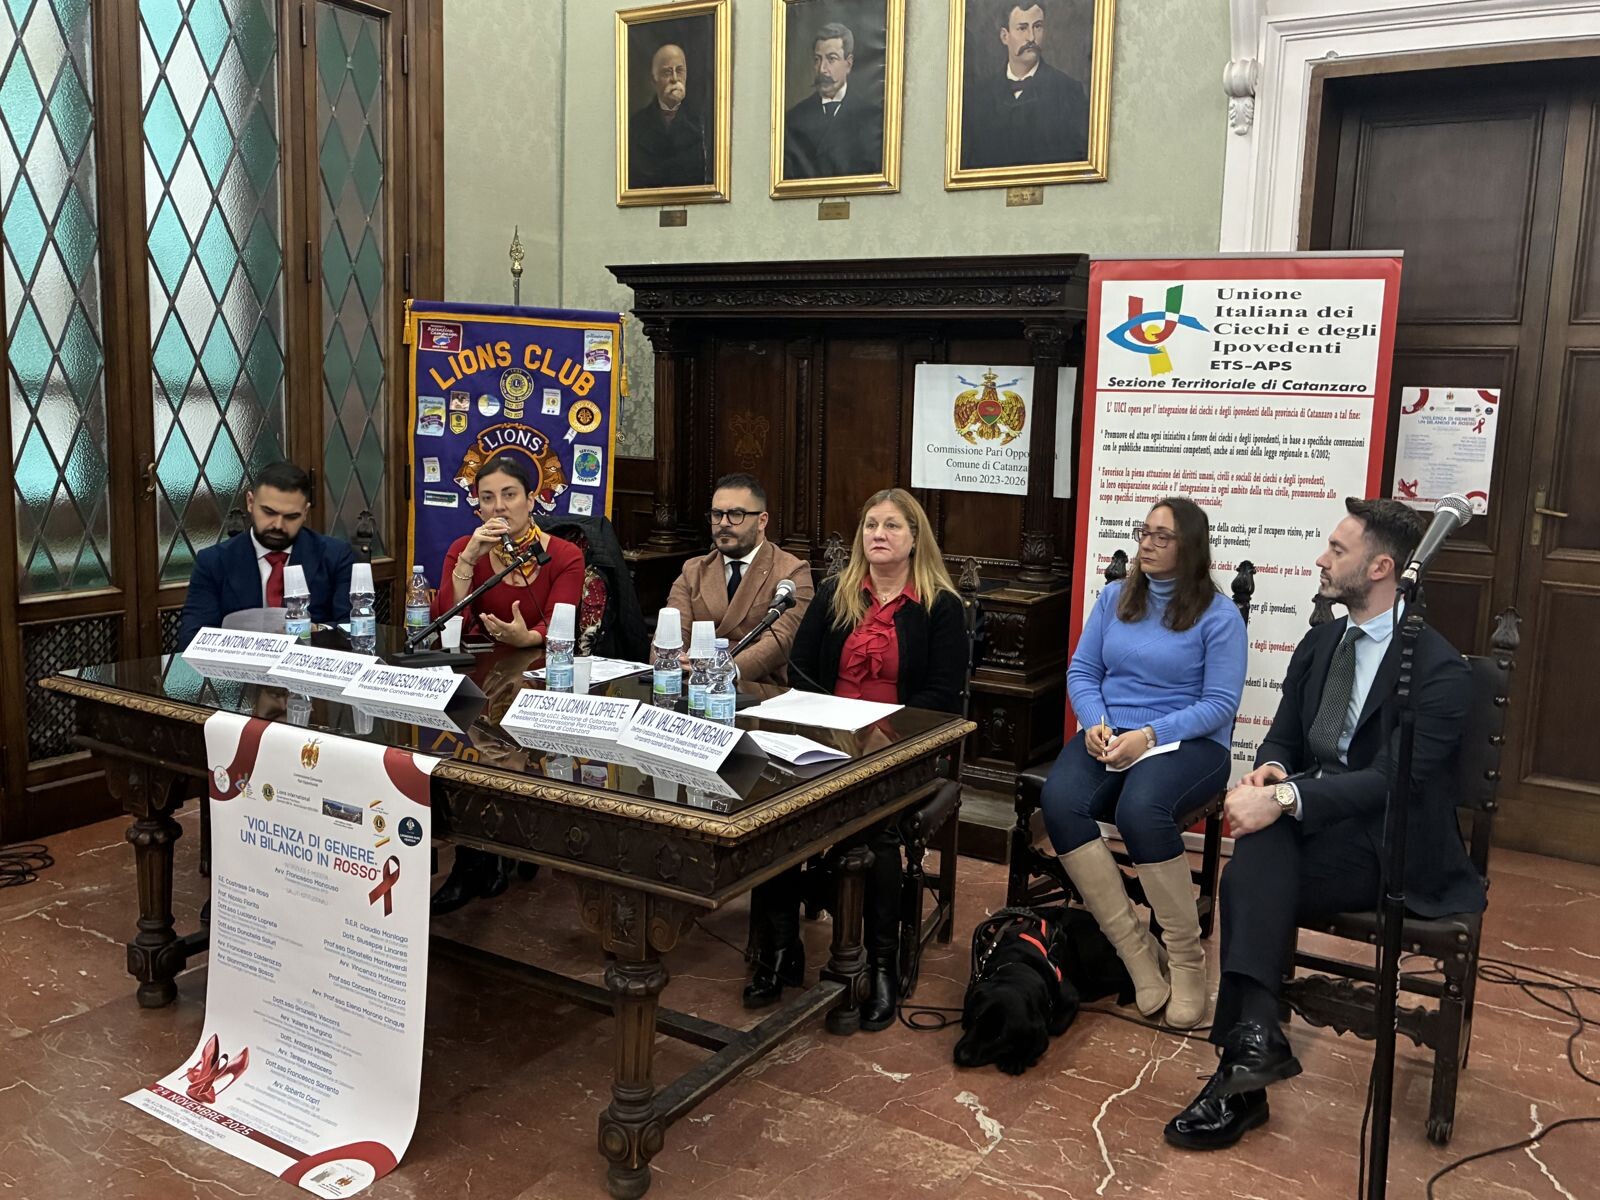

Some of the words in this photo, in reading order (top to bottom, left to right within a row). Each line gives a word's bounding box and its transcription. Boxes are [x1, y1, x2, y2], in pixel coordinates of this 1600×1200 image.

[1216, 288, 1303, 301] Unione
[1215, 306, 1307, 318] Italiana
[1316, 305, 1354, 318] dei
[1213, 323, 1290, 336] Ciechi
[1297, 326, 1310, 336] e
[1317, 324, 1377, 340] degli
[1212, 340, 1342, 355] Ipovedenti
[429, 341, 512, 390] LIONS
[524, 344, 596, 397] CLUB
[1210, 360, 1293, 371] ETS-APS
[1107, 377, 1167, 388] Sezione
[1171, 378, 1256, 390] Territoriale
[1261, 379, 1278, 390] di
[1281, 380, 1368, 393] Catanzaro
[1113, 403, 1126, 413] UICI
[1127, 406, 1141, 415] opera
[1157, 404, 1187, 417] integrazione
[1189, 405, 1197, 415] dei
[1198, 405, 1212, 415] ciechi
[1219, 406, 1231, 418] degli
[1232, 406, 1259, 419] ipovedenti
[1260, 407, 1273, 417] della
[1274, 407, 1298, 420] provincia
[1306, 408, 1332, 419] Catanzaro
[1339, 409, 1347, 419] tal
[1348, 409, 1360, 419] fine:
[483, 429, 543, 452] LIONS
[1104, 429, 1127, 439] Promuove
[1136, 431, 1149, 440] attua
[1150, 430, 1161, 442] ogni
[1162, 430, 1185, 441] iniziativa
[1191, 431, 1207, 442] favore
[1208, 432, 1216, 442] dei
[1218, 432, 1232, 442] ciechi
[1238, 433, 1251, 445] degli
[1252, 433, 1280, 446] ipovedenti,
[1289, 434, 1300, 444] base
[1307, 435, 1331, 447] specifiche
[1333, 436, 1364, 446] convenzioni
[926, 444, 983, 456] Commissione
[986, 447, 1003, 456] Pari
[1118, 442, 1141, 454] pubbliche
[1142, 442, 1181, 453] amministrazioni
[1182, 444, 1211, 456] competenti,
[1213, 445, 1227, 455] anche
[1235, 445, 1248, 456] sensi
[1250, 446, 1262, 456] della
[1263, 446, 1277, 459] legge
[1278, 447, 1302, 459] regionale
[1310, 448, 1330, 460] 6/2002;
[946, 458, 980, 469] Comune
[982, 460, 990, 470] di
[954, 473, 977, 483] Anno
[980, 474, 1026, 486] 2023-2026
[1101, 466, 1123, 477] Favorisce
[1131, 467, 1144, 480] piena
[1146, 468, 1171, 479] attuazione
[1172, 469, 1180, 479] dei
[1181, 469, 1197, 480] diritti
[1198, 470, 1215, 482] umani,
[1216, 471, 1229, 481] civili
[1235, 471, 1251, 482] sociali
[1252, 472, 1261, 482] dei
[1262, 472, 1277, 483] ciechi
[1283, 473, 1295, 486] degli
[1297, 474, 1325, 487] ipovedenti,
[196, 633, 218, 646] DOTT.
[218, 635, 253, 650] ANTONIO
[251, 638, 288, 653] MIRIELLO
[281, 652, 312, 667] DOTT.SSA
[308, 656, 342, 672] GRAZIELLA
[357, 683, 388, 692] Presidente
[388, 688, 424, 697] Controvento
[373, 671, 418, 688] FRANCESCO
[414, 676, 453, 693] MANCUSO
[518, 693, 557, 711] DOTT.SSA
[555, 698, 590, 715] LUCIANA
[589, 702, 627, 719] LOPRETE
[510, 713, 539, 721] Presidente
[538, 717, 575, 726] Commissione
[517, 709, 546, 717] Presidente
[588, 718, 616, 726] Catanzaro
[532, 722, 555, 730] Comune
[561, 726, 590, 734] Catanzaro
[655, 713, 692, 736] VALERIO
[687, 722, 732, 747] MURGANO
[240, 830, 256, 845] UN
[260, 838, 313, 862] BILANCIO
[317, 851, 329, 867] IN
[309, 833, 320, 847] DI
[324, 838, 377, 866] GENERE.
[152, 1086, 168, 1096] 24
[168, 1093, 221, 1122] NOVEMBRE
[221, 1119, 254, 1136] 2025
